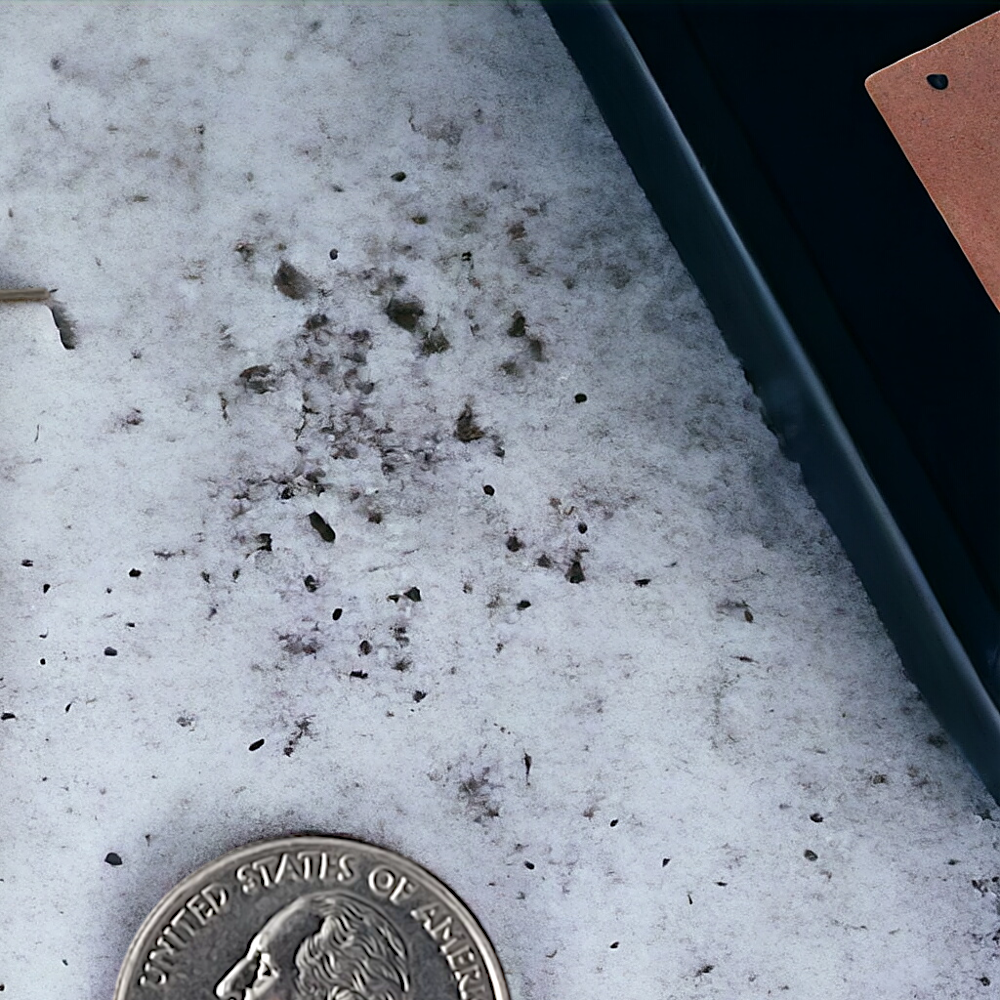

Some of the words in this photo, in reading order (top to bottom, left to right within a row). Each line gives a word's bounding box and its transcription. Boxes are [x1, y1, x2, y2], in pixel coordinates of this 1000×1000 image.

[139, 882, 229, 988] UNITED
[235, 851, 357, 893] STATES
[367, 865, 417, 903] OF
